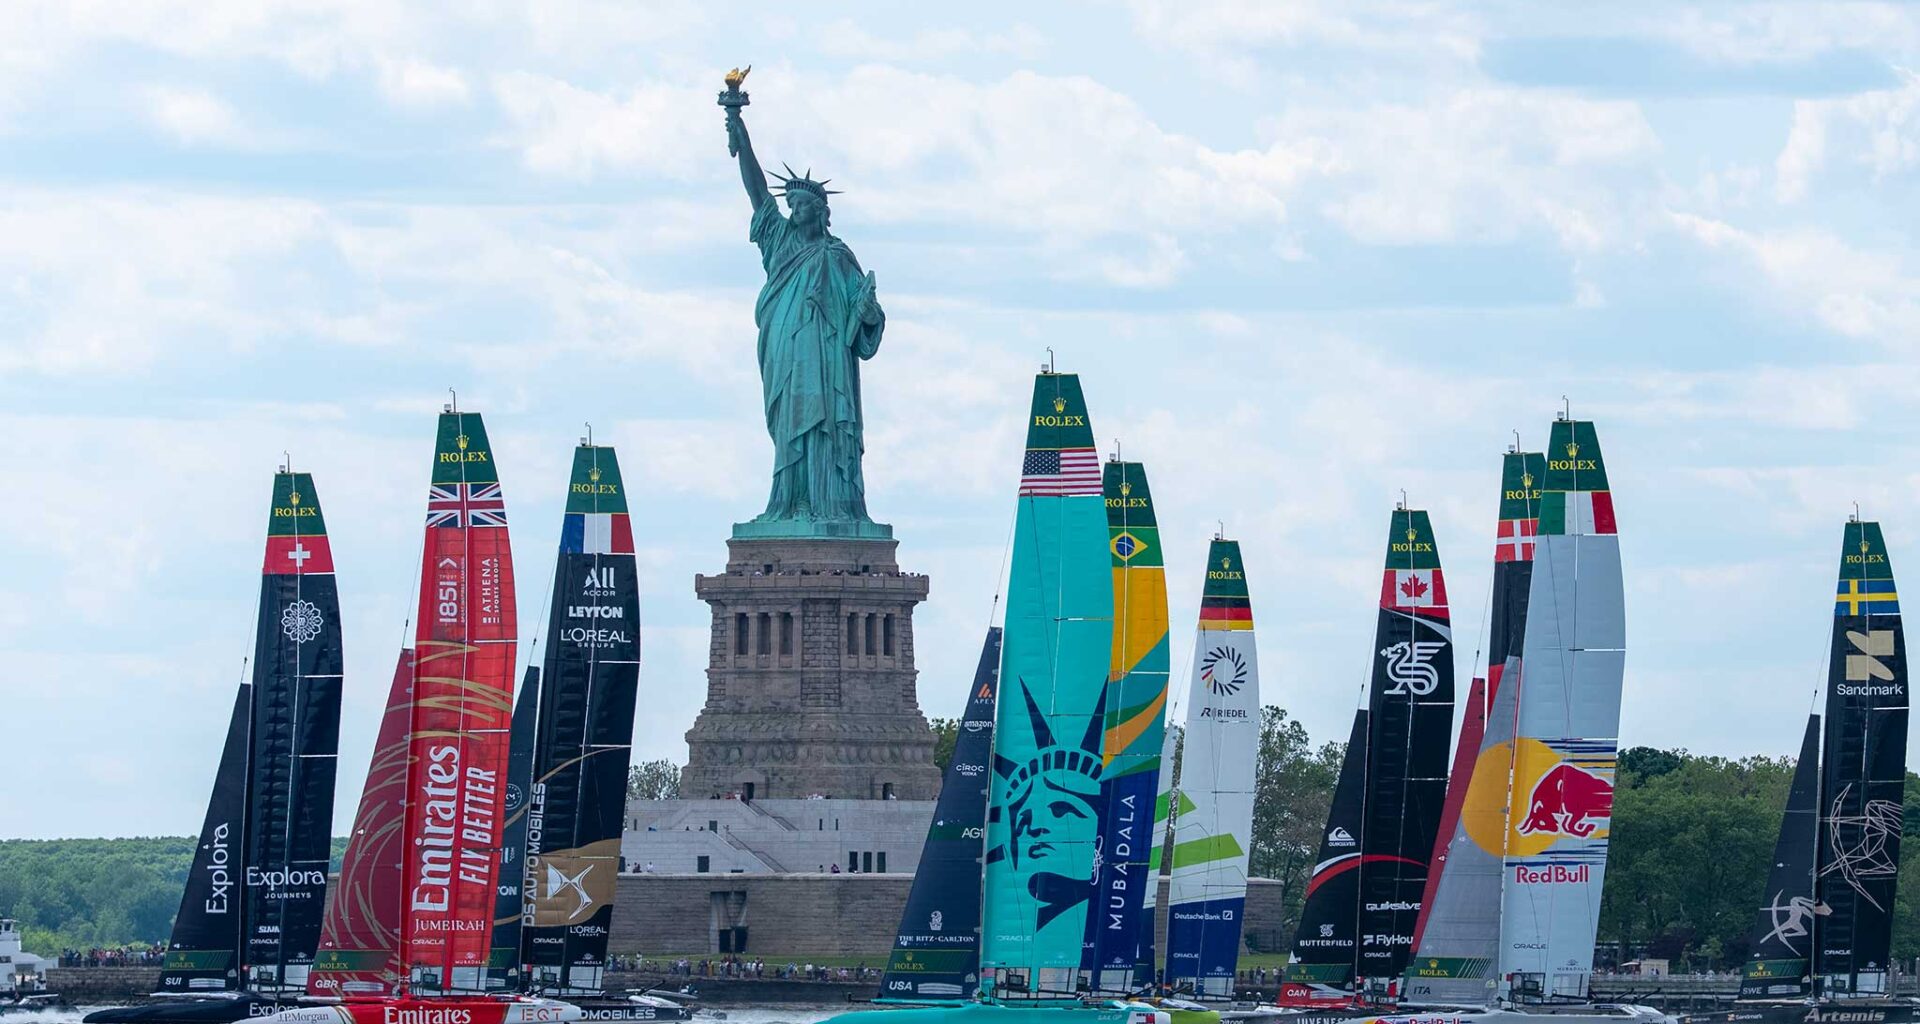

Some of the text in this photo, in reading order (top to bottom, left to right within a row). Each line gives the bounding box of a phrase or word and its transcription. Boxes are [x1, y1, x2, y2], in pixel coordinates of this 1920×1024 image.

[1035, 416, 1084, 426] ROLEX
[439, 451, 487, 463] ROLEX
[1550, 460, 1596, 470] ROLEX
[572, 483, 617, 494] ROLEX
[1506, 490, 1542, 500] ROLE
[1104, 498, 1148, 507] ROLEX
[274, 507, 316, 517] ROLEX
[1392, 543, 1432, 552] ROLEX
[1846, 554, 1884, 564] ROLEX
[1208, 571, 1242, 580] ROLEX
[482, 558, 492, 613] ATHENA
[439, 581, 458, 623] 1851
[568, 605, 623, 618] LEYTON
[1836, 683, 1903, 696] Sandmark
[1217, 709, 1248, 718] RIEDEL
[964, 720, 993, 728] amazon
[411, 745, 460, 913] Emirates
[459, 766, 496, 886] FLY BETTER
[961, 827, 984, 839] AG1
[523, 782, 546, 927] DS AUTOMOBILES
[1108, 794, 1136, 930] MUBADALA
[205, 823, 233, 914] Explora
[1516, 865, 1590, 883] Red Bull
[246, 866, 326, 890] Explora
[414, 918, 485, 933] JUMEIRAH
[1376, 934, 1414, 946] FlyHou
[165, 977, 182, 985] SUI
[315, 980, 338, 988] GBR
[888, 981, 912, 991] USA
[1287, 989, 1308, 997] CAN
[1413, 986, 1431, 995] ITA
[1742, 987, 1763, 995] SWE
[384, 1006, 471, 1024] Emirates
[521, 1008, 563, 1021] EQT
[580, 1008, 656, 1021] OMOBILES
[1804, 1008, 1886, 1022] Artemis
